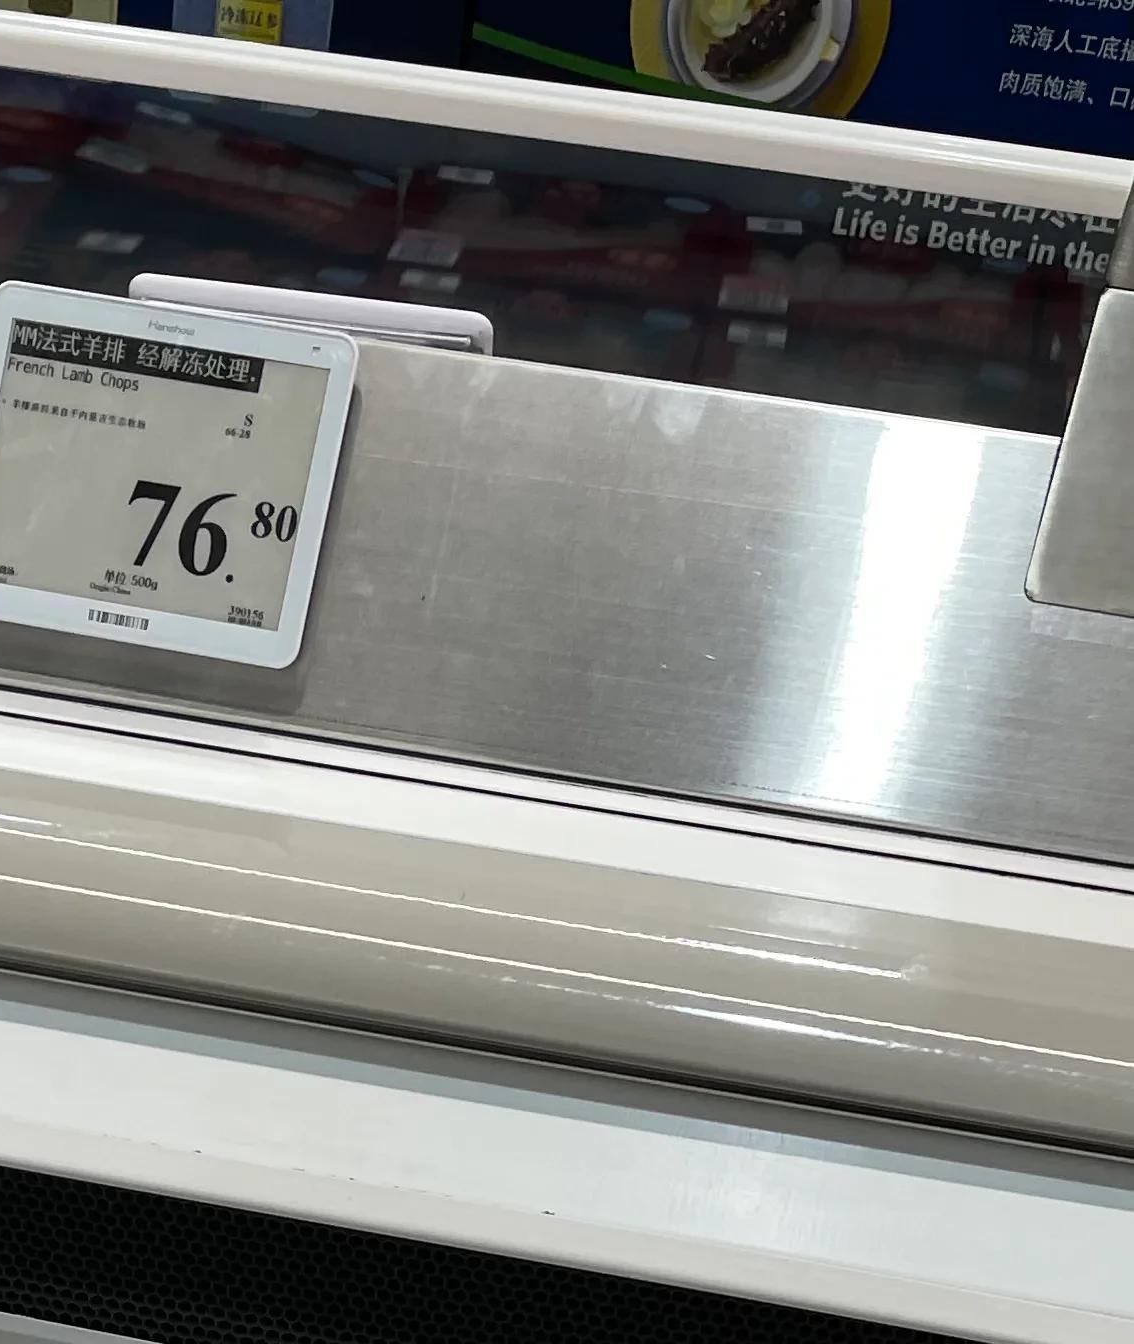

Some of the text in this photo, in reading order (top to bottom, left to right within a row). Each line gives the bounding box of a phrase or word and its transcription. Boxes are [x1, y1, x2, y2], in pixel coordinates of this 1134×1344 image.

[998, 69, 1134, 111] 肉质饱满、口
[832, 206, 1110, 273] Life is Better in the
[13, 323, 128, 364] MM法式羊排
[7, 356, 140, 392] French Lamb Chops
[243, 413, 254, 427] S
[130, 574, 159, 591] 500g
